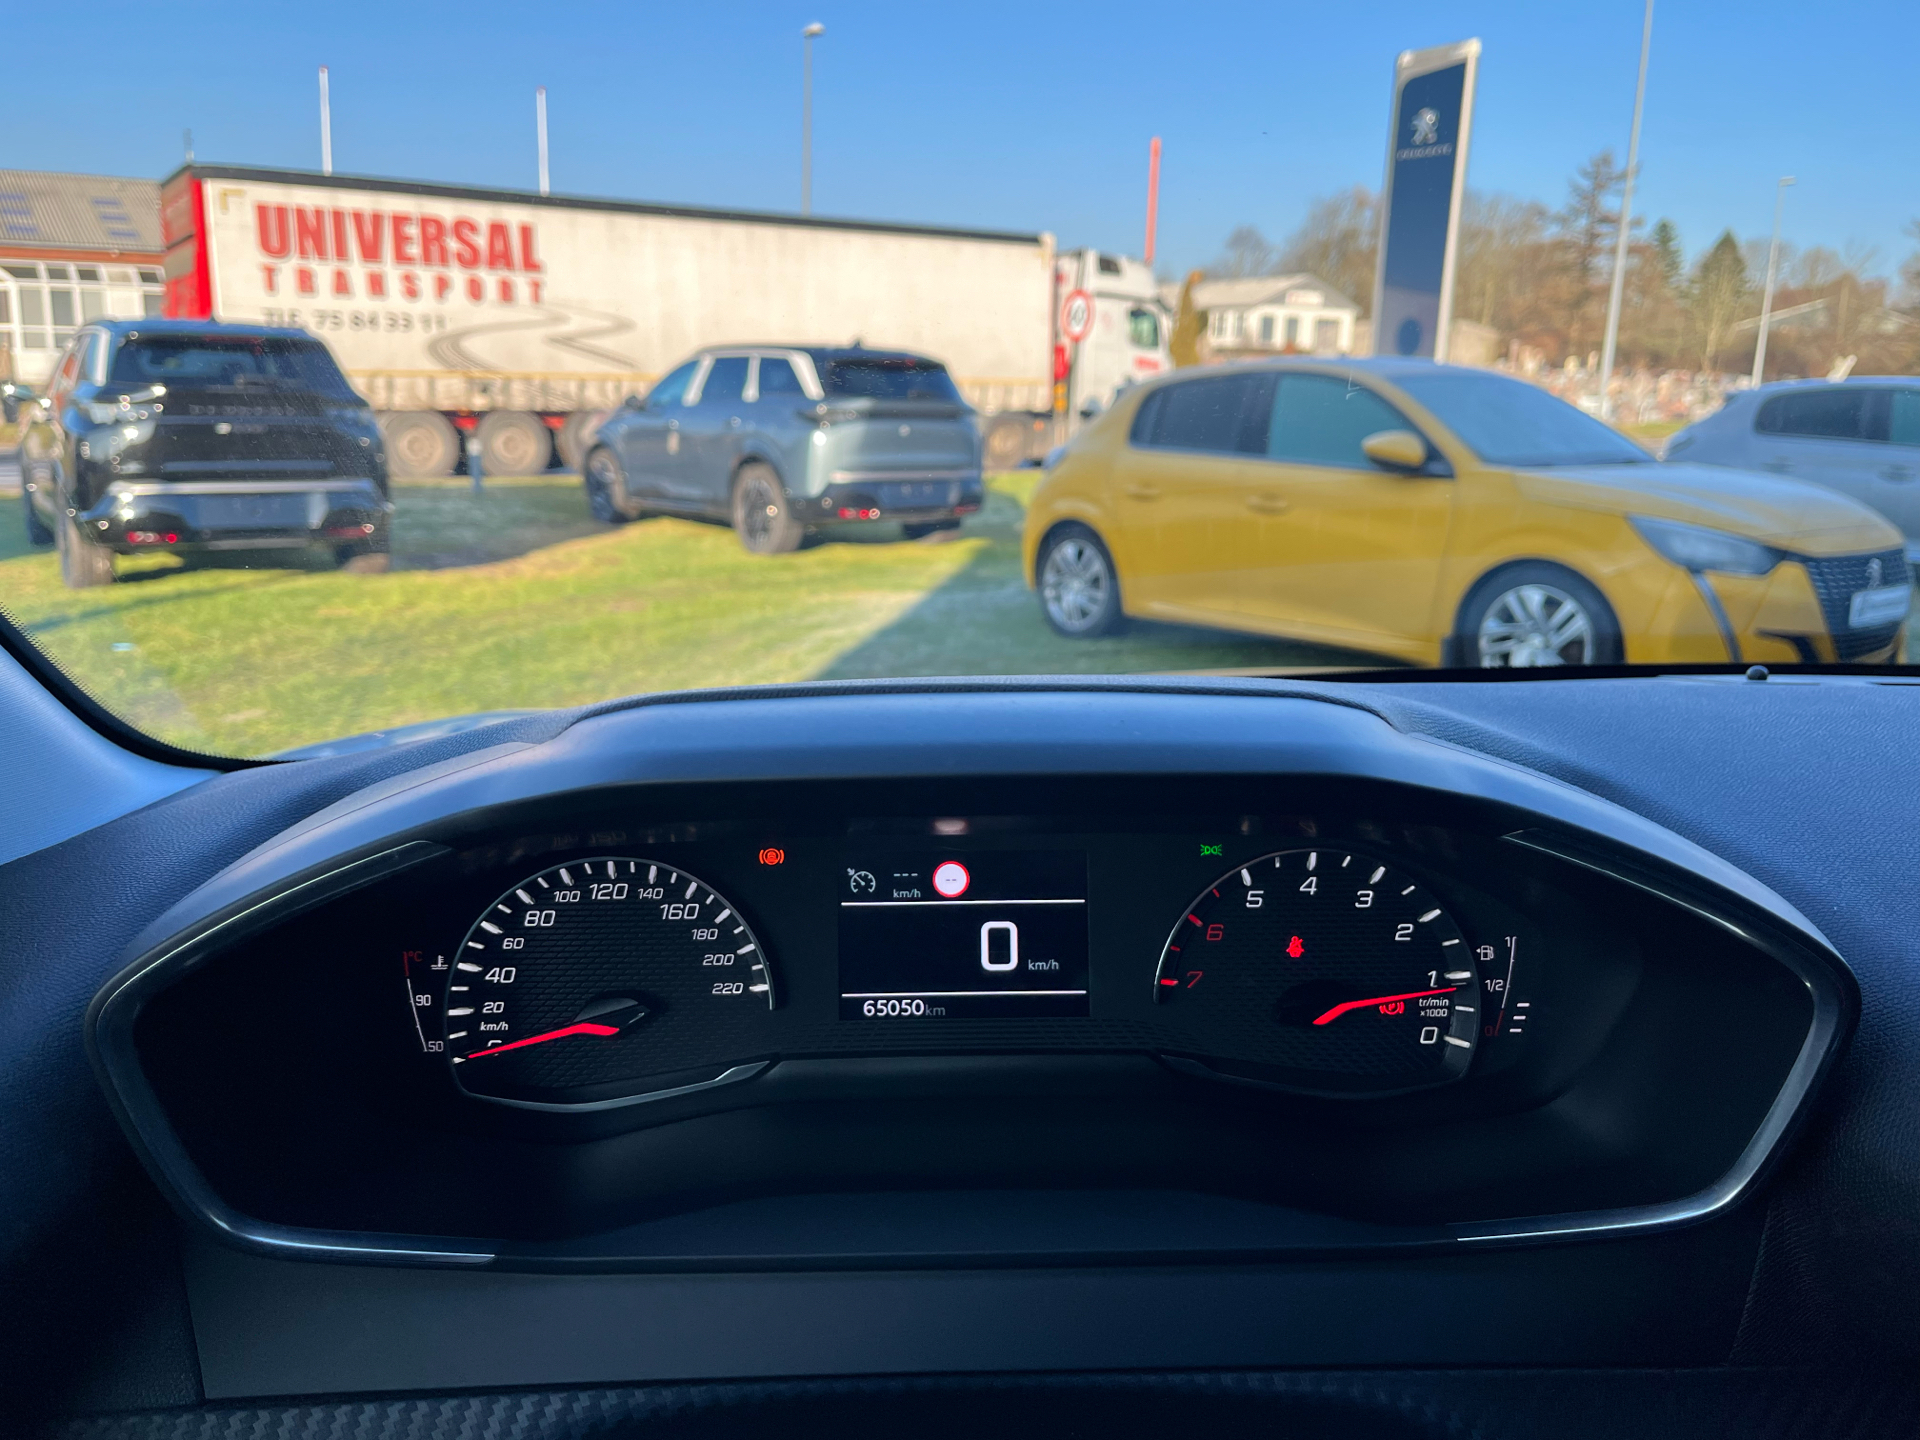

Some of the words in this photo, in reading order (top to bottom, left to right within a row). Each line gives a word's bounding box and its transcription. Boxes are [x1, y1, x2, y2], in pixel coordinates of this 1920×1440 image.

[257, 203, 543, 272] UNIVERSAL
[261, 265, 546, 304] TRANSPORT
[314, 310, 345, 331] 75
[590, 884, 628, 899] 120
[638, 888, 663, 899] 140
[893, 888, 921, 898] km/h
[1300, 877, 1317, 895] 4
[554, 891, 580, 902] 100
[1246, 891, 1264, 907] 5
[1355, 891, 1373, 907] 3
[524, 910, 555, 926] 80
[660, 904, 699, 919] 160
[692, 929, 718, 940] 180
[1207, 924, 1223, 940] 6
[1395, 924, 1413, 940] 2
[503, 938, 524, 949] 60
[981, 921, 1018, 971] 0
[1028, 959, 1059, 970] km/h
[1505, 937, 1511, 947] 1
[703, 954, 734, 965] 200
[485, 968, 516, 983] 40
[1188, 972, 1202, 988] 7
[1428, 971, 1437, 987] 1
[712, 983, 743, 994] 220
[1485, 979, 1503, 992] 1/2
[416, 995, 431, 1006] 90
[483, 1002, 504, 1013] 20
[863, 1000, 924, 1016] 65050
[1419, 998, 1449, 1007] tr/min
[480, 1022, 508, 1030] km/h
[1420, 1027, 1438, 1044] 0
[429, 1041, 443, 1052] 50
